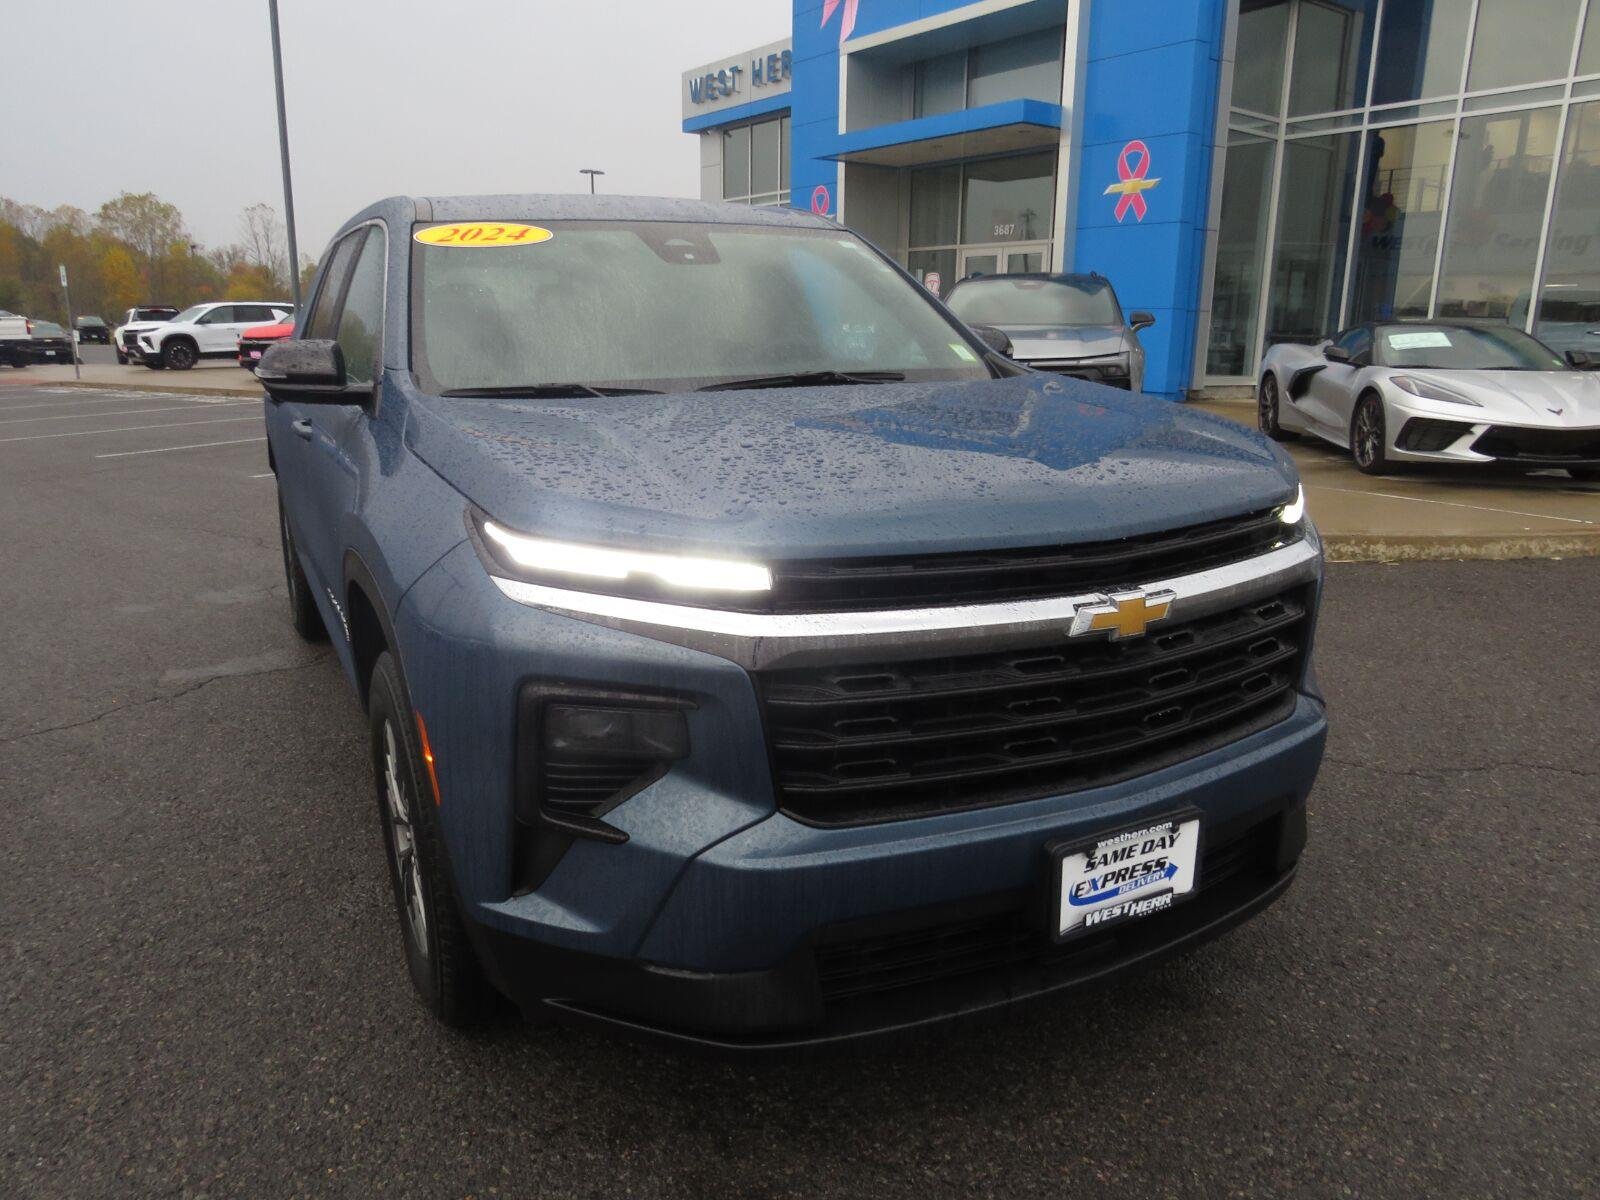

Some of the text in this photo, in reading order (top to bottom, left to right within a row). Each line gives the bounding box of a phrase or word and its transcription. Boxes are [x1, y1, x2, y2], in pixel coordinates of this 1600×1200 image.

[688, 65, 742, 104] WEST
[436, 227, 531, 243] 2024
[994, 224, 1015, 236] 3687
[1096, 821, 1173, 848] westherr.com
[1084, 833, 1181, 873] SAME DAY
[1073, 856, 1169, 897] EXPRESS
[1118, 869, 1167, 895] DELIVERY
